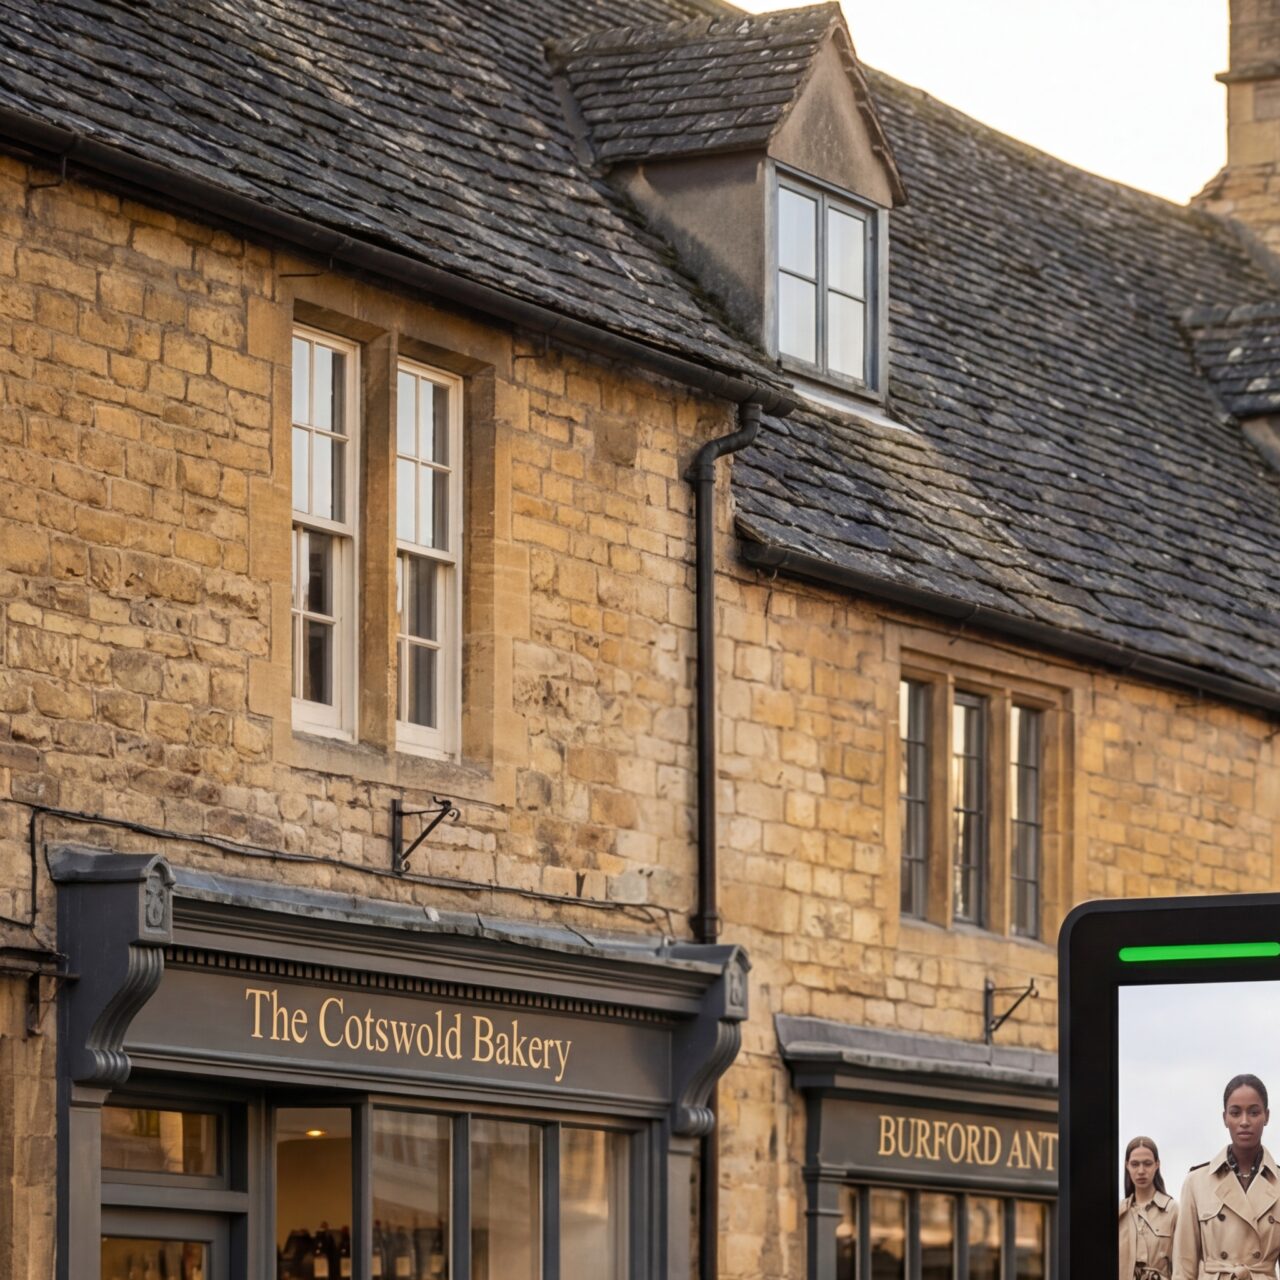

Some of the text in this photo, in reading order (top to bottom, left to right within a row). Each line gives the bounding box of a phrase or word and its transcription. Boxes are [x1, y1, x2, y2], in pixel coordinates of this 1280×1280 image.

[246, 988, 572, 1082] The Cotswold Bakery
[878, 1115, 1001, 1165] BURFORD
